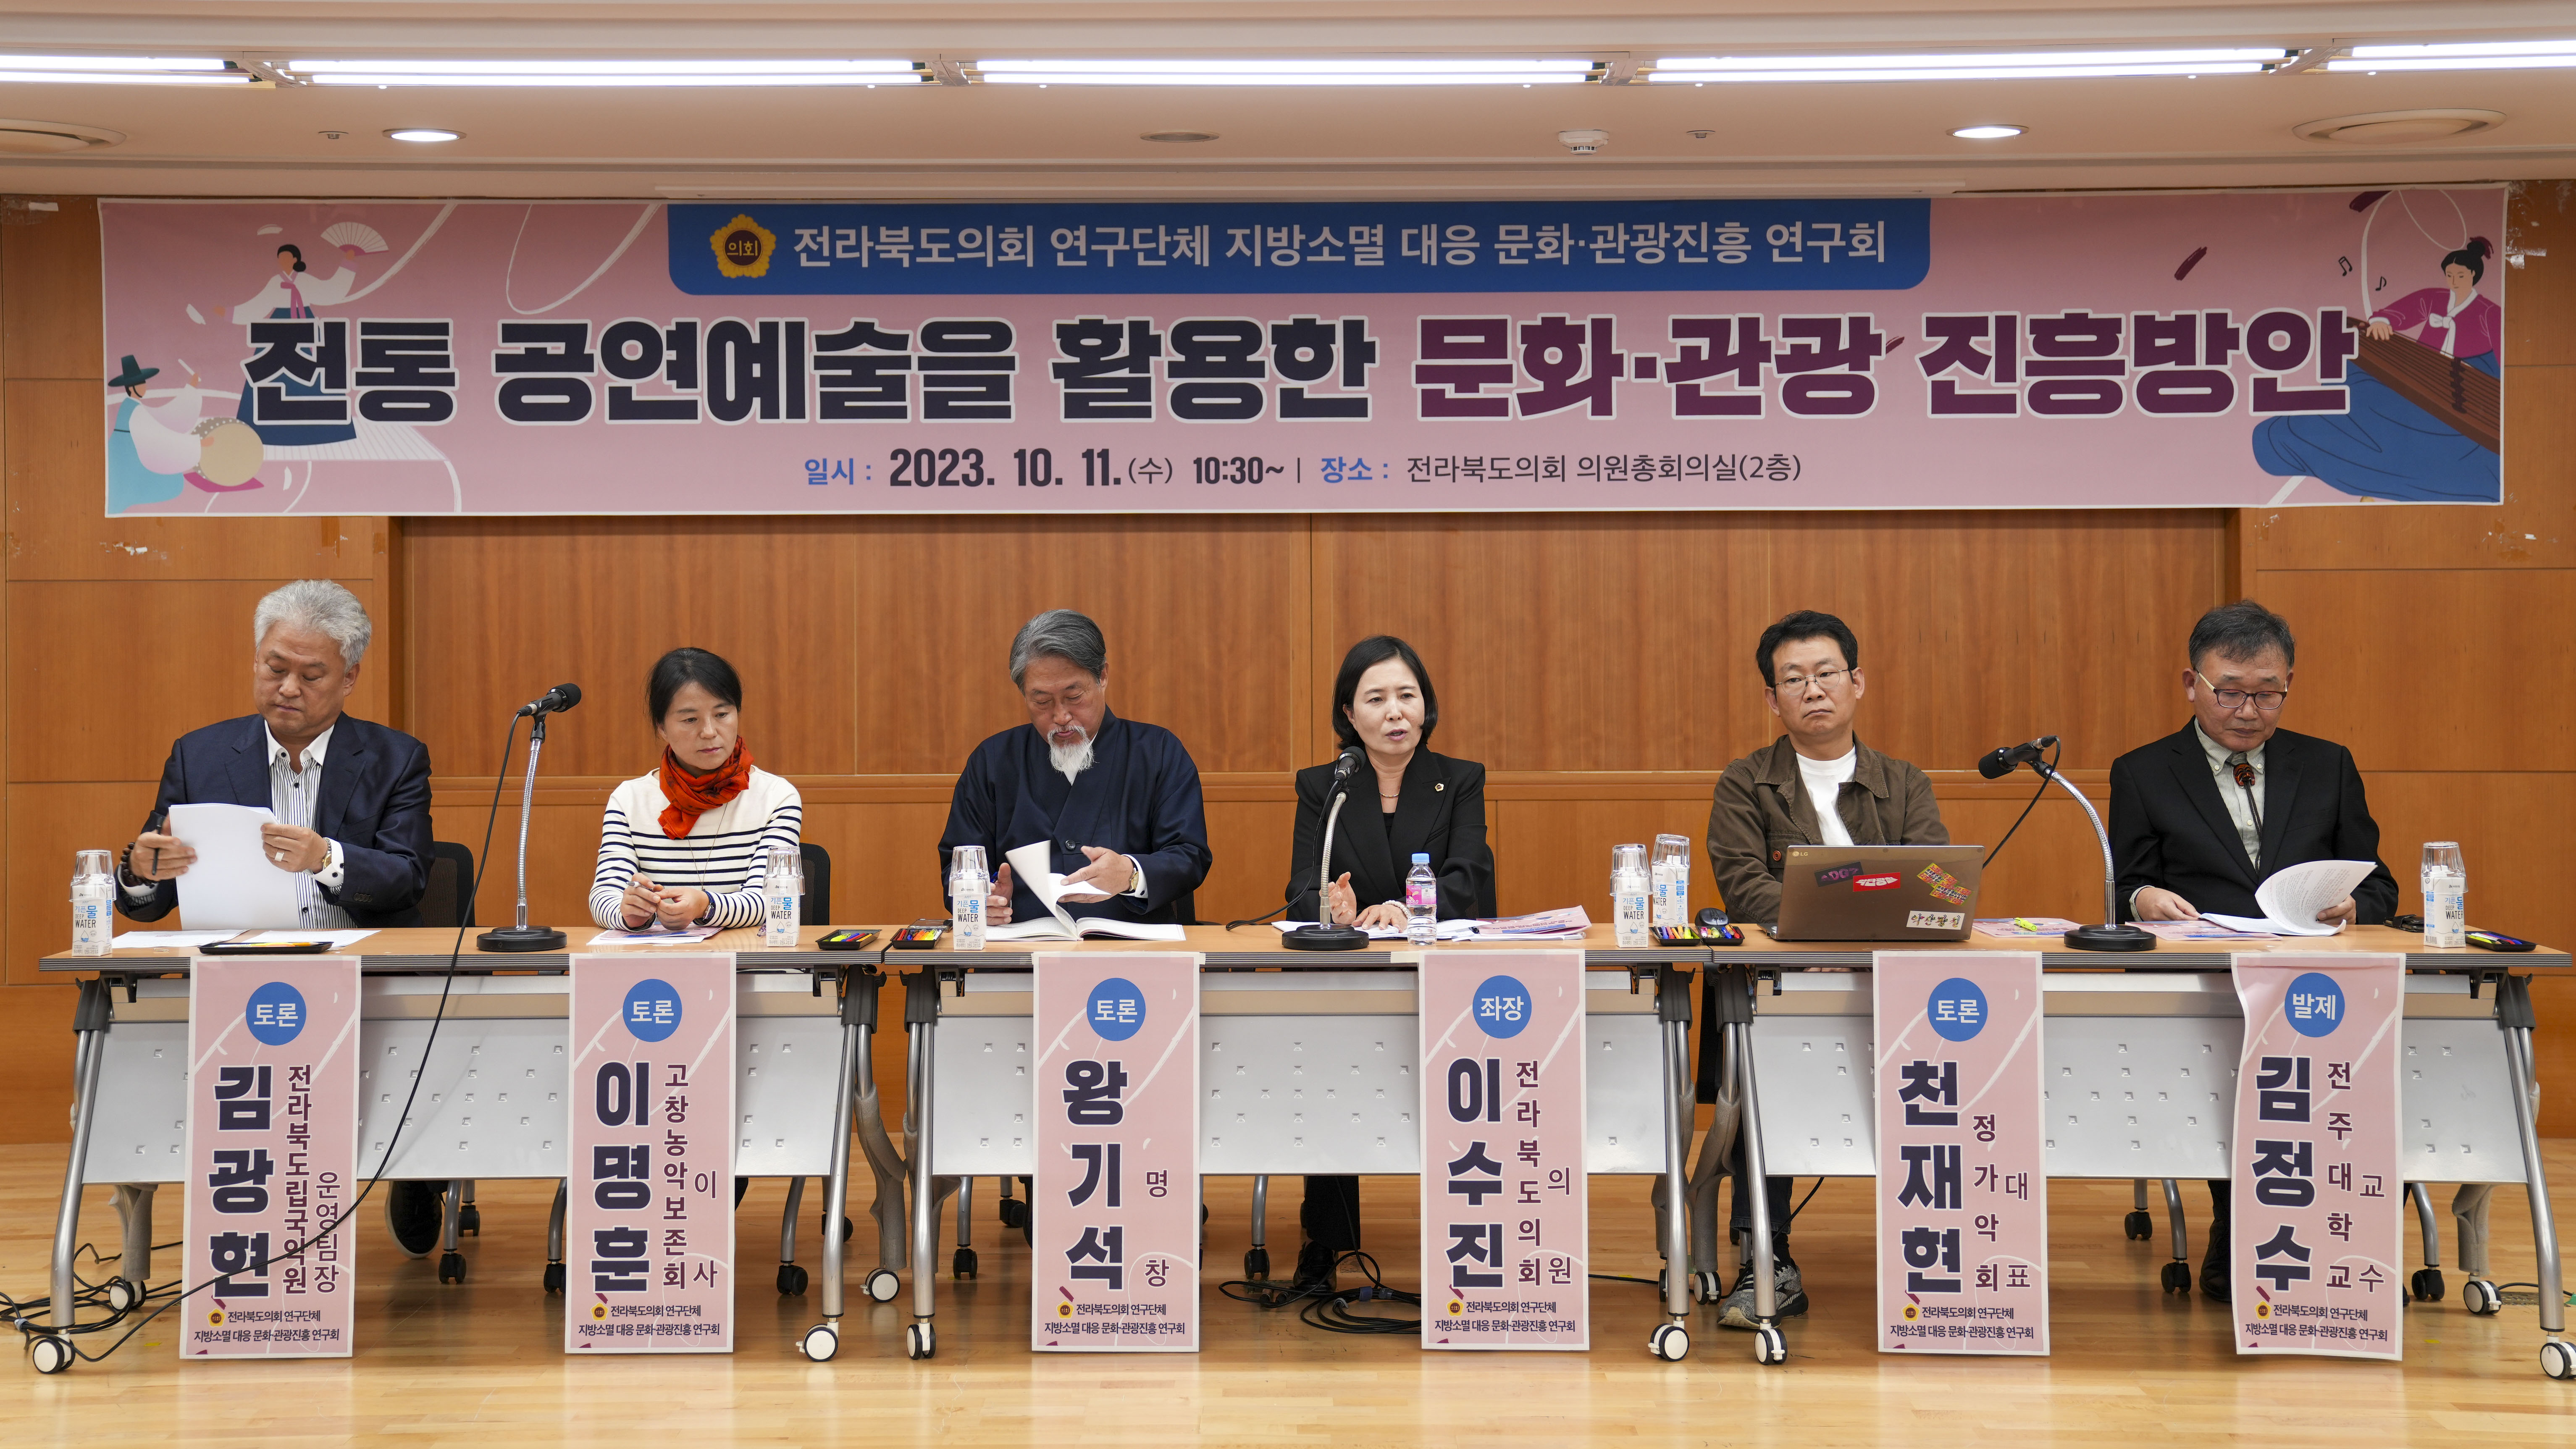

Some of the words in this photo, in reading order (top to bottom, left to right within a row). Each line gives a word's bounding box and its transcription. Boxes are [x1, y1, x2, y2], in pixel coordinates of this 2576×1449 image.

[727, 240, 758, 256] 의회
[794, 225, 1034, 268] 전라북도의회
[1050, 225, 1209, 267] 연구단체
[1225, 224, 1385, 267] 지방소멸
[1401, 224, 1480, 266] 대응
[1494, 222, 1751, 265] 문화·관광진흥
[1766, 221, 1885, 263] 연구회
[245, 320, 457, 423] 전통
[494, 319, 1016, 423] 공연예술을
[1051, 317, 1377, 420] 활용한
[1414, 315, 1883, 418] 문화·관광
[1918, 310, 2357, 416] 진흥방안
[804, 458, 854, 485] 일시
[890, 448, 995, 488] 2023.
[1013, 447, 1063, 487] 10.
[1193, 456, 1285, 485] 10:30~
[1321, 456, 1373, 483] 장소
[1407, 454, 1565, 483] 전라북도의회
[1576, 453, 1801, 483] 의원총회의실(2층)
[771, 911, 791, 919] WATER
[1624, 911, 1644, 919] WATER
[2446, 911, 2463, 919] WATER
[255, 1004, 297, 1026] 토론
[631, 1001, 674, 1023] 토론
[1095, 1000, 1137, 1022] 토론
[1481, 996, 1523, 1020] 좌장
[1936, 1000, 1978, 1023] 토론
[2293, 994, 2335, 1019] 발제
[209, 1066, 274, 1298] 김광현
[282, 1064, 312, 1294] 전라북도립국악원
[591, 1062, 651, 1292] 이명훈
[663, 1064, 689, 1290] 고창농악보존회
[1063, 1060, 1128, 1290] 왕기석
[1446, 1058, 1503, 1288] 이수진
[1515, 1060, 1541, 1286] 전라북도의회
[1897, 1060, 1962, 1293] 천재현
[2251, 1056, 2316, 1291] 김정수
[2326, 1061, 2353, 1289] 전주대학교
[1972, 1114, 1999, 1290] 정가악회
[228, 1310, 282, 1323] 전라북도의회
[284, 1310, 320, 1322] 연구단체
[611, 1305, 664, 1317] 전라북도의회
[665, 1305, 701, 1317] 연구단체
[1076, 1303, 1129, 1315] 전라북도의회
[1131, 1304, 1166, 1315] 연구단체
[1466, 1301, 1519, 1313] 전라북도의회
[1520, 1301, 1556, 1313] 연구단체
[1922, 1306, 1976, 1319] 전라북도의회
[1977, 1307, 2014, 1320] 연구단체
[2274, 1304, 2328, 1319] 전라북도의회
[2330, 1307, 2368, 1322] 연구단체
[194, 1330, 231, 1343] 지방소멸
[233, 1330, 252, 1342] 대응
[253, 1329, 310, 1341] 문화·관광진흥
[312, 1328, 339, 1341] 연구회
[578, 1324, 614, 1336] 지방소멸
[616, 1323, 634, 1336] 대응
[635, 1323, 692, 1336] 문화·관광진흥
[693, 1323, 719, 1336] 연구회
[1045, 1322, 1080, 1334] 지방소멸
[1082, 1322, 1100, 1334] 대응
[1101, 1322, 1157, 1334] 문화·관광진흥
[1158, 1322, 1185, 1334] 연구회
[1435, 1319, 1470, 1331] 지방소멸
[1472, 1320, 1490, 1332] 대응
[1491, 1320, 1547, 1332] 문화·관광진흥
[1548, 1320, 1575, 1332] 연구회
[1890, 1324, 1926, 1337] 지방소멸
[1928, 1325, 1947, 1337] 대응
[1948, 1326, 2005, 1339] 문화·관광진흥
[2006, 1326, 2034, 1339] 연구회
[2245, 1323, 2278, 1336] 지방소멸
[2279, 1323, 2297, 1336] 대응
[2298, 1324, 2358, 1339] 문화·관광진흥
[2359, 1328, 2387, 1341] 연구회
